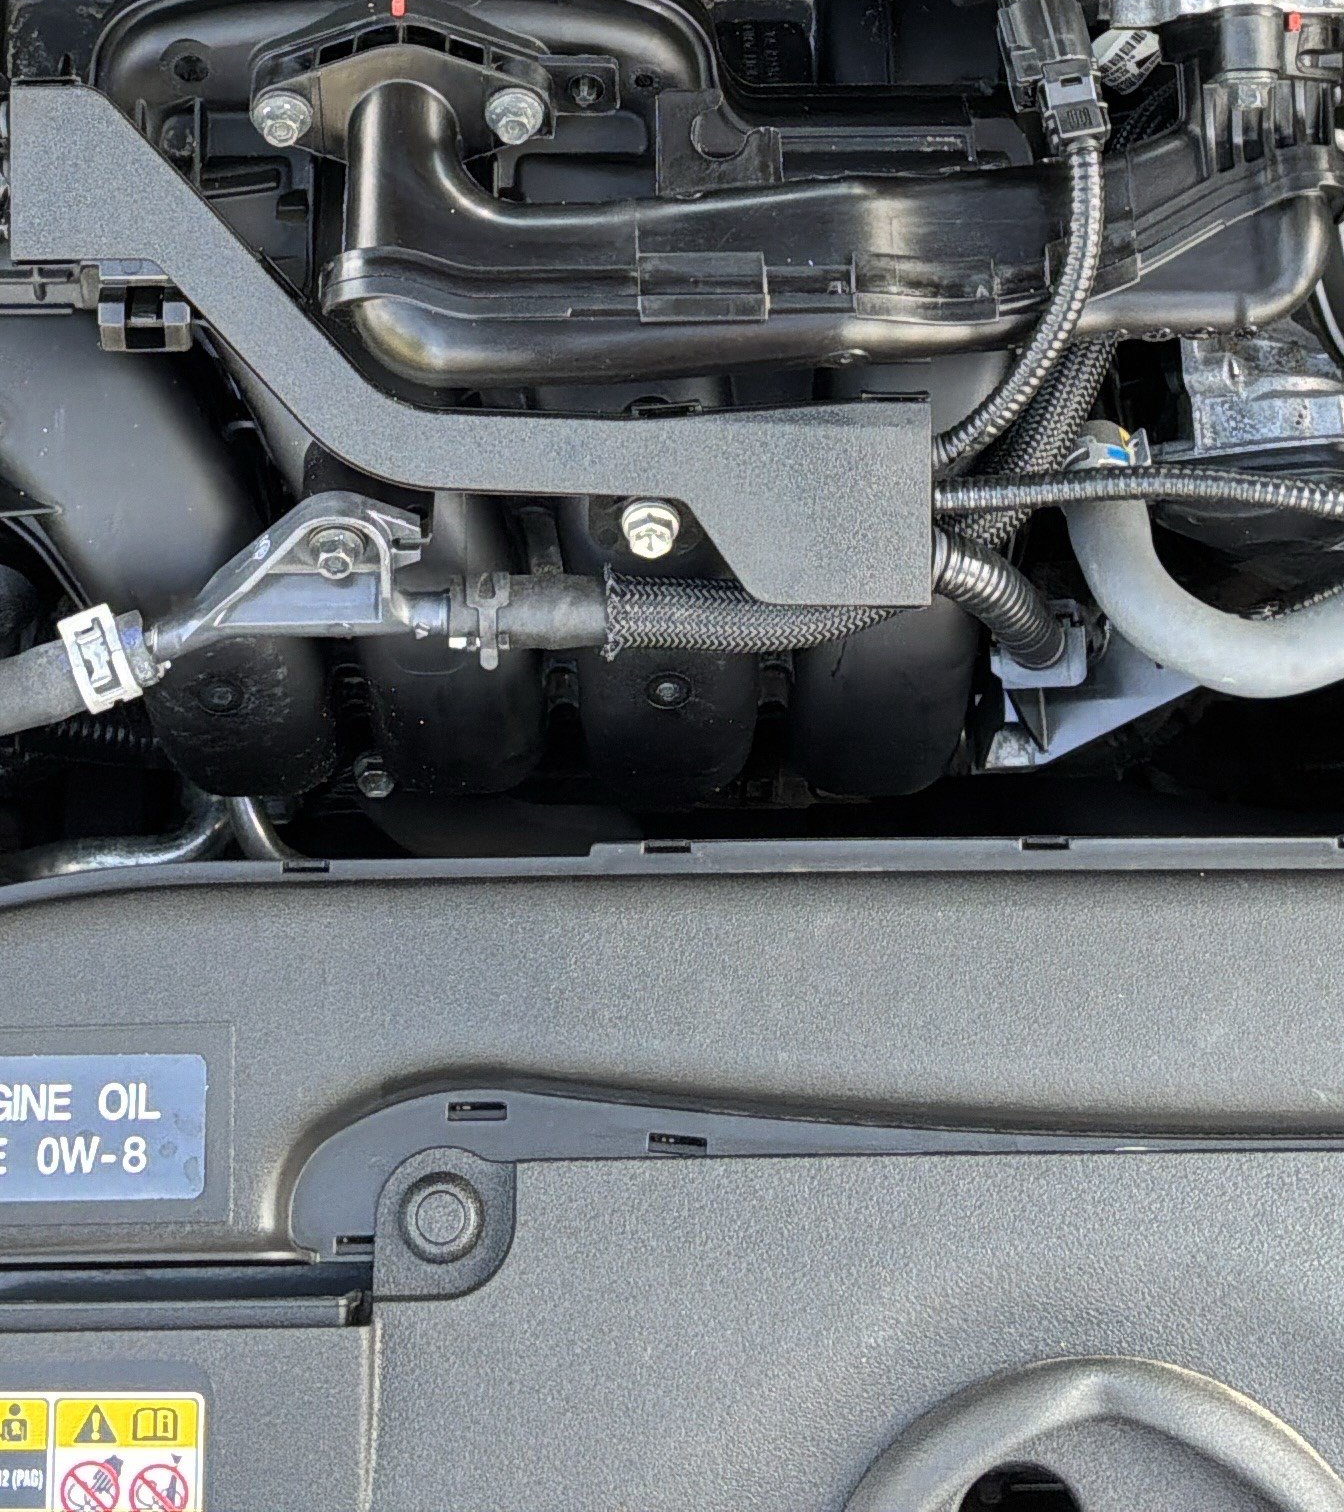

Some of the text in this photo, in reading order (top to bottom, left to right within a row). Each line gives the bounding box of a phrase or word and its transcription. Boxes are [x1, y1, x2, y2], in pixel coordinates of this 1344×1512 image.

[97, 1082, 162, 1121] OIL
[36, 1134, 148, 1175] 0W-8
[12, 1467, 44, 1492] (PAG)
